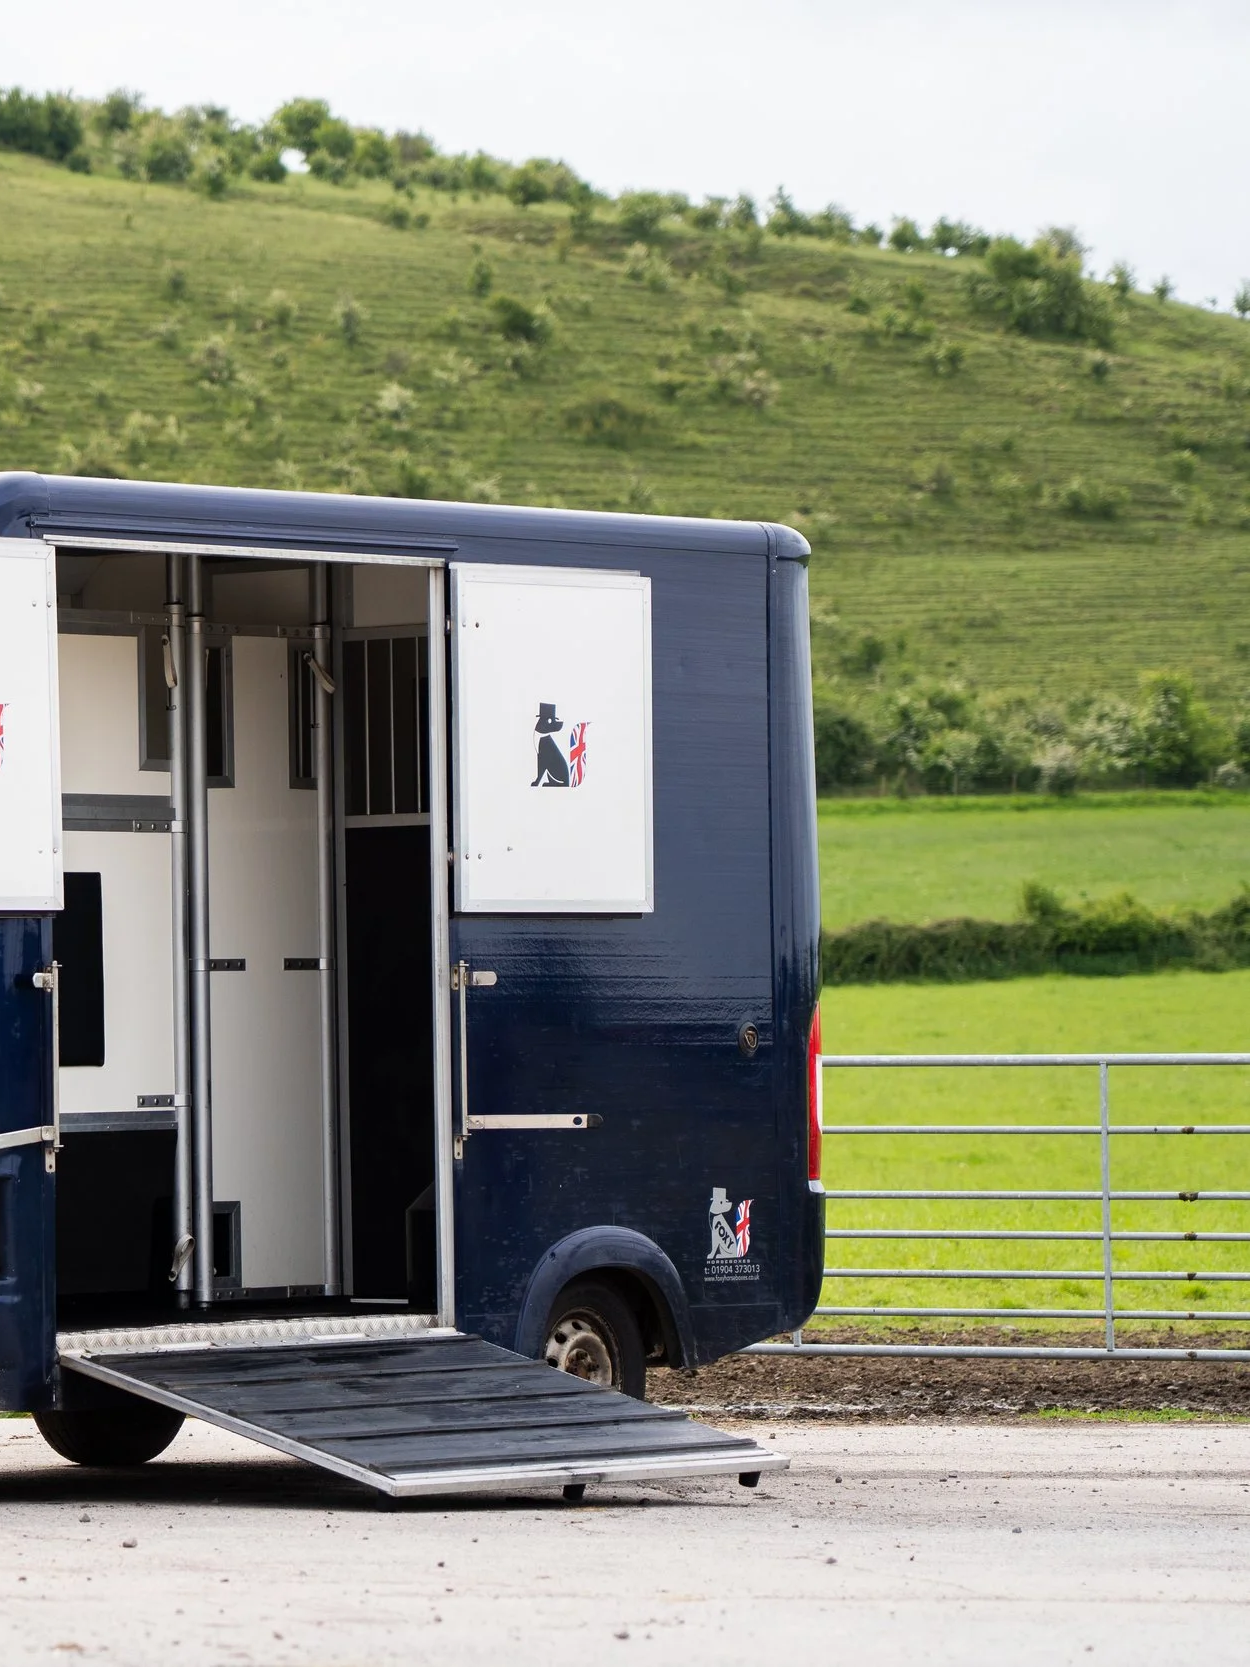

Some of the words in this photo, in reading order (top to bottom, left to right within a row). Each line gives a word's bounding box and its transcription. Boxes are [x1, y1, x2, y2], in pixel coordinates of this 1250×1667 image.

[714, 1220, 734, 1249] FOXY
[711, 1265, 733, 1274] 01904
[734, 1264, 761, 1273] 373013
